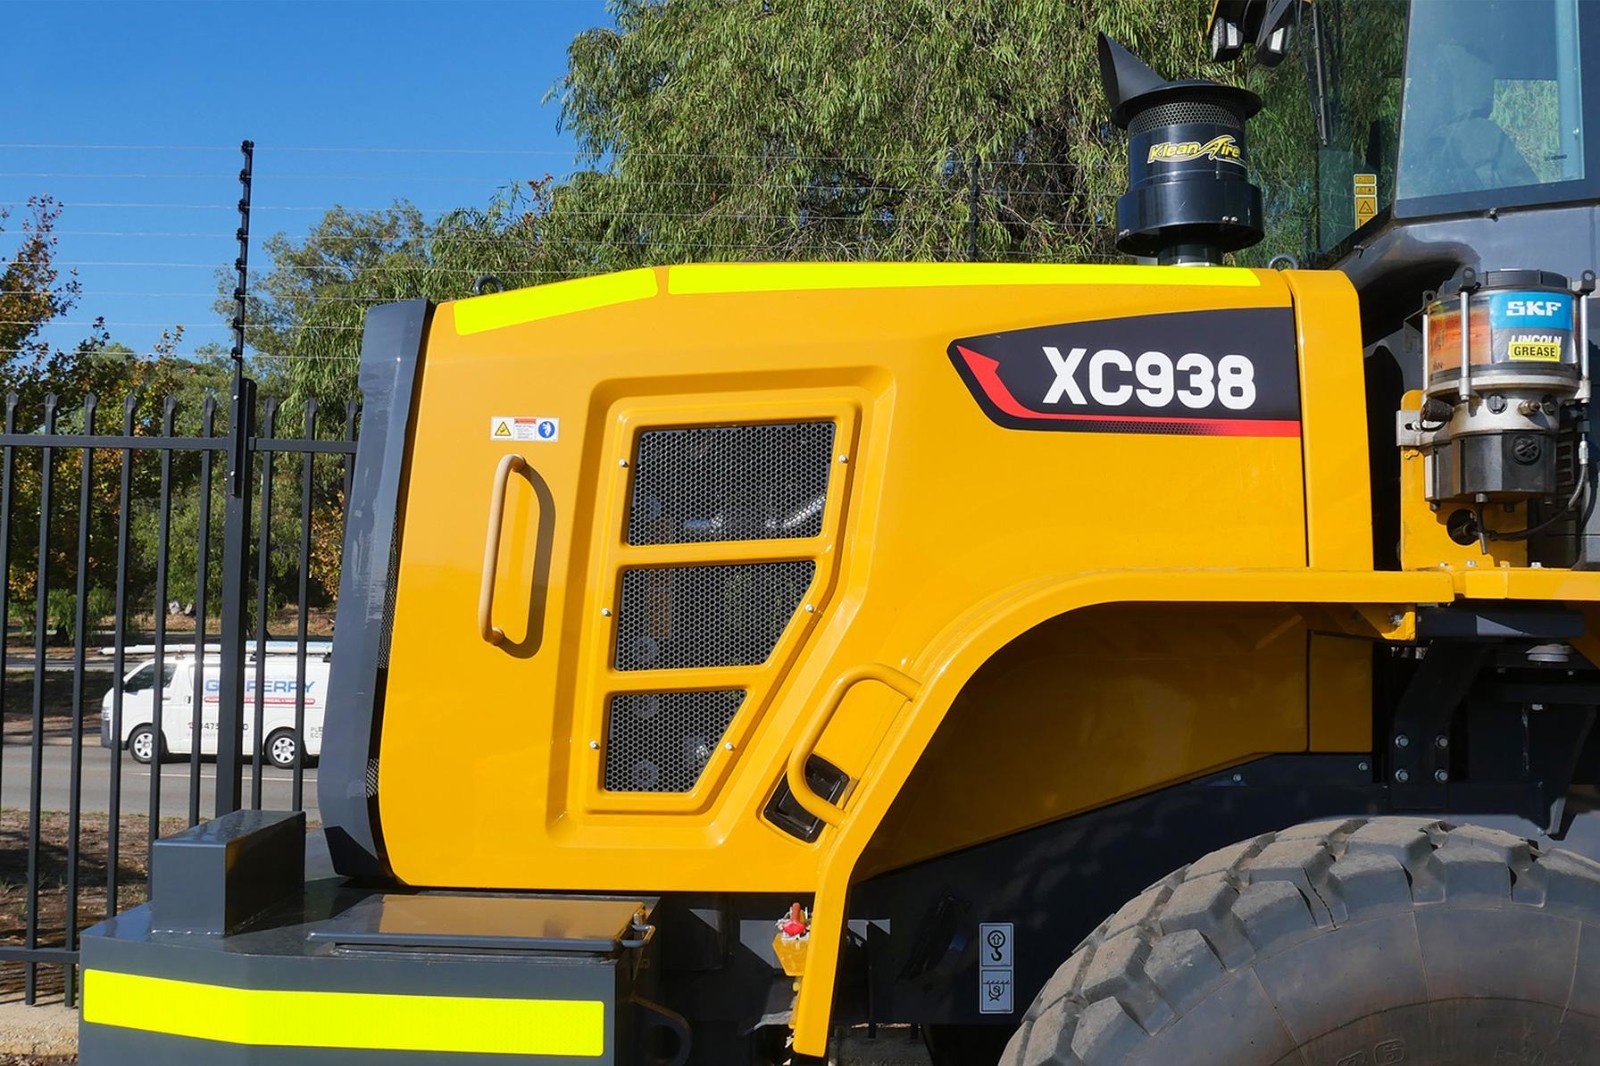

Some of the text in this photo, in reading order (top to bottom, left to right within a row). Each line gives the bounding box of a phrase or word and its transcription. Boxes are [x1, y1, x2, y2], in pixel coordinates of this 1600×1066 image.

[1506, 301, 1562, 316] SKF
[1514, 346, 1555, 357] GREASE
[1042, 346, 1256, 410] XC938
